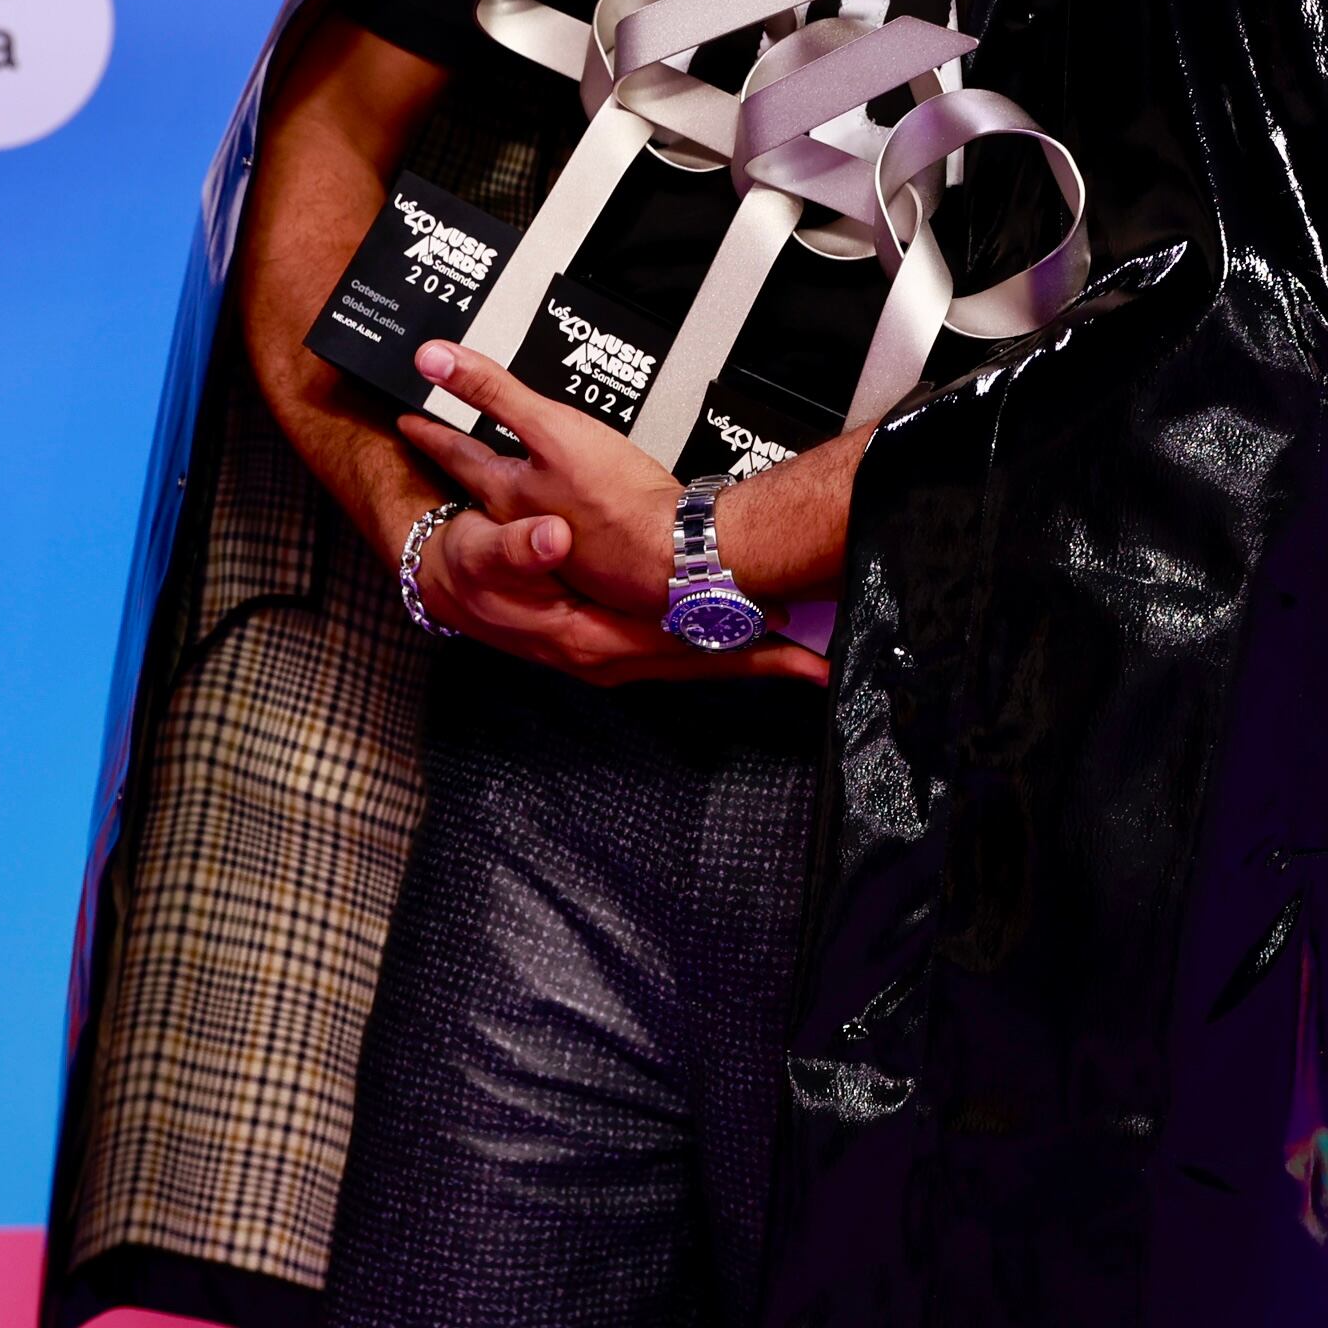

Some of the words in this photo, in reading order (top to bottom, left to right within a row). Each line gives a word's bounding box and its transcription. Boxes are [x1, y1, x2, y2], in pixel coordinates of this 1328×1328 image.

[403, 234, 489, 281] AWARDS
[432, 220, 498, 266] MUSIC
[405, 265, 473, 312] 2024
[432, 260, 480, 291] Santander
[332, 311, 358, 330] MEJOR
[341, 295, 375, 318] Global
[373, 312, 406, 336] Latina
[561, 342, 649, 389] AWARDS
[588, 326, 656, 374] MUSIC
[565, 374, 634, 423] 2024
[591, 368, 641, 400] Santander
